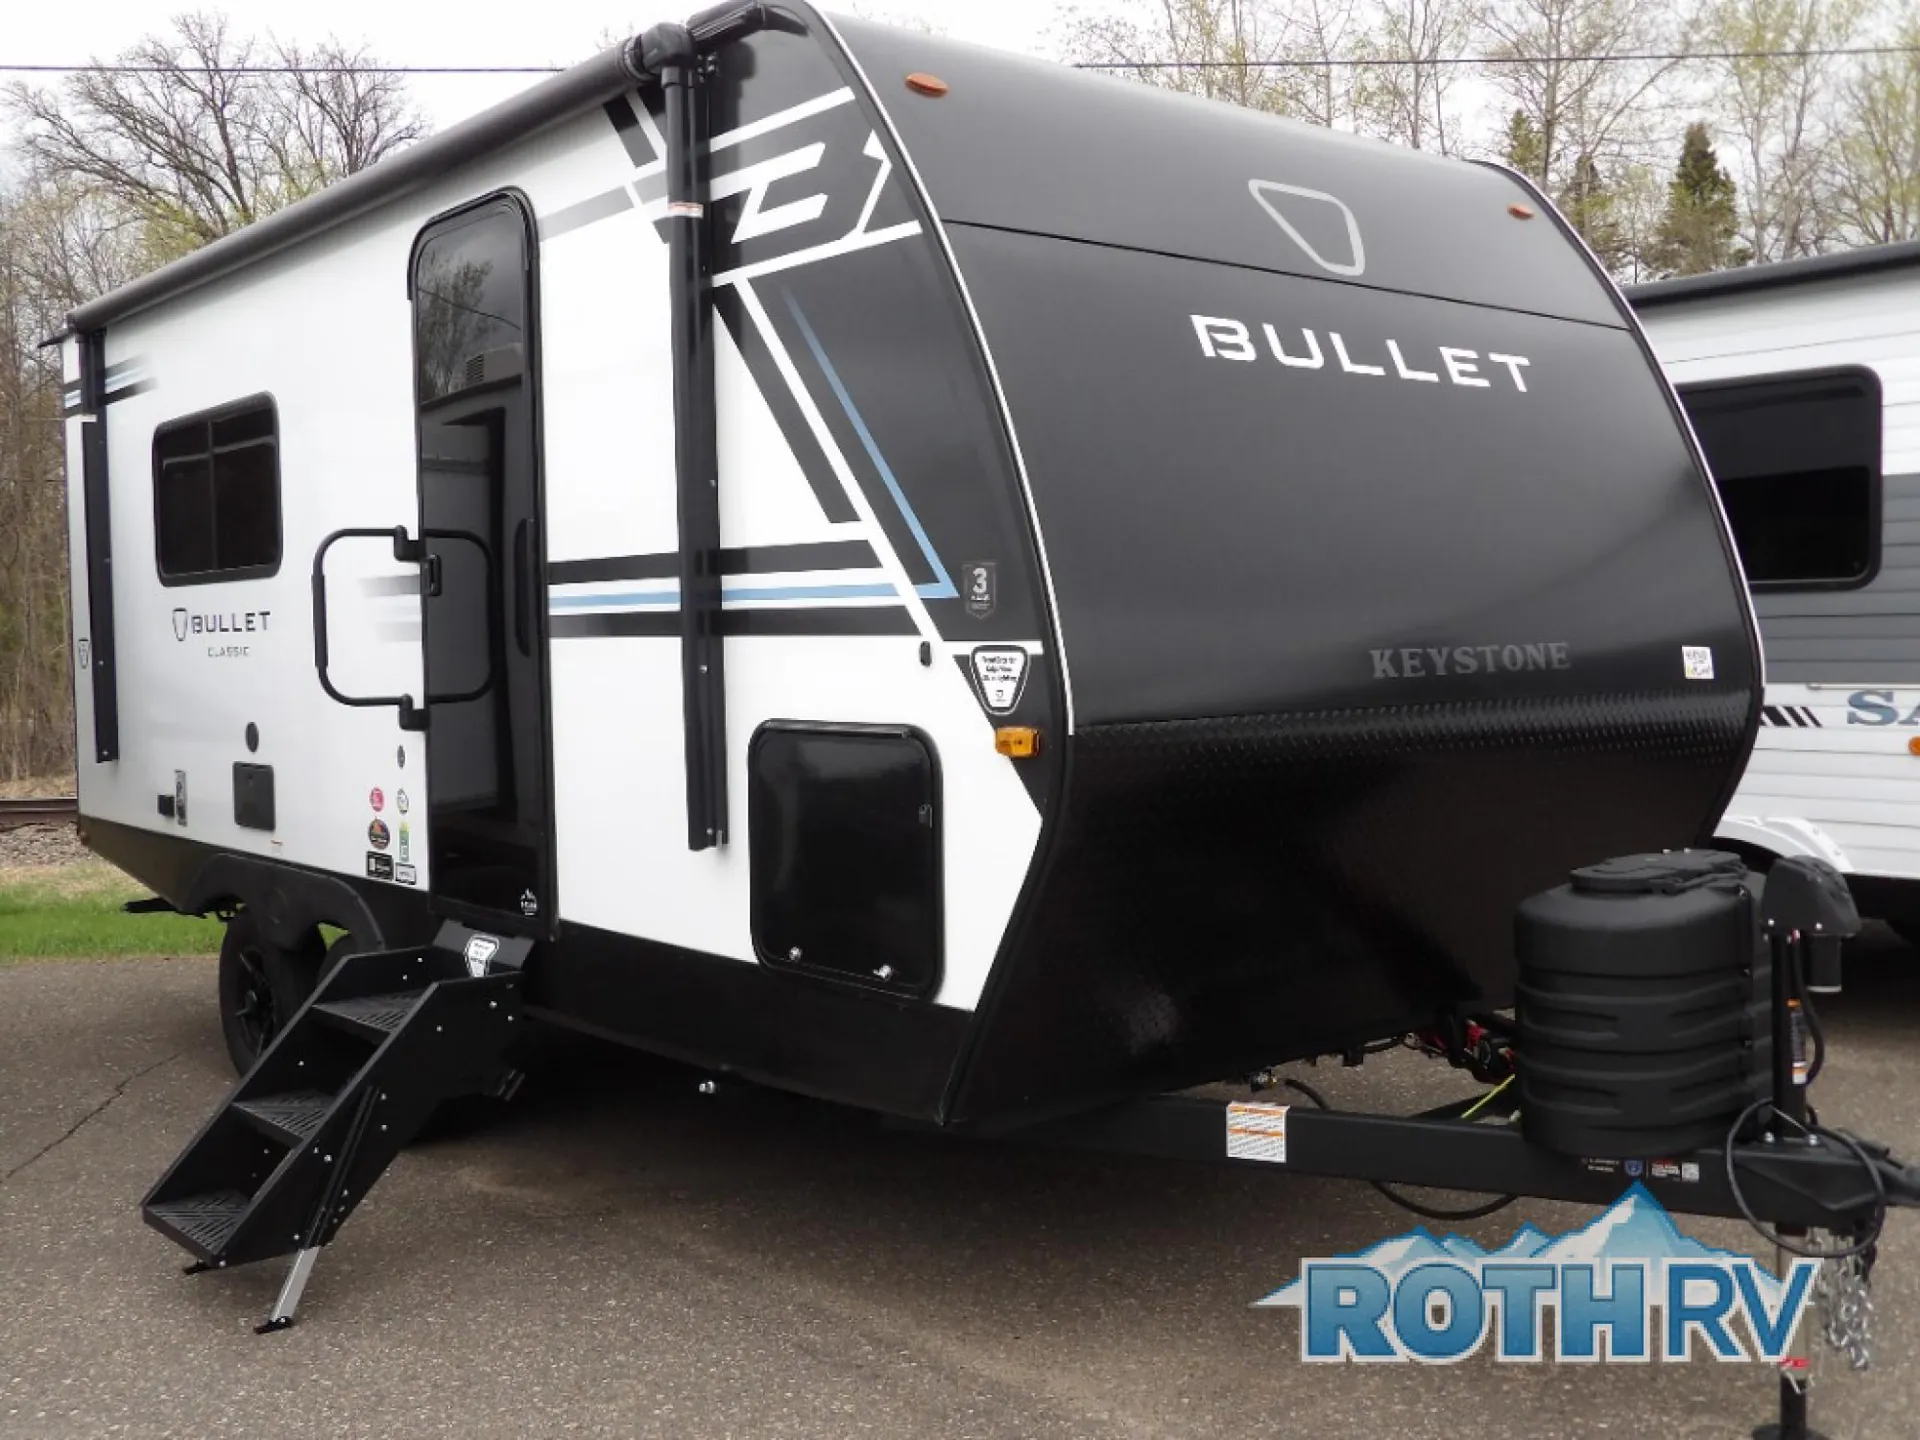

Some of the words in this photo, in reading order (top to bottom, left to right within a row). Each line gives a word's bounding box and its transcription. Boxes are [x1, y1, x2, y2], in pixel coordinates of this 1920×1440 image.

[1189, 314, 1531, 392] BULLET
[972, 567, 987, 594] 3
[191, 610, 271, 634] BULLET
[1369, 642, 1572, 679] KEYSTONE
